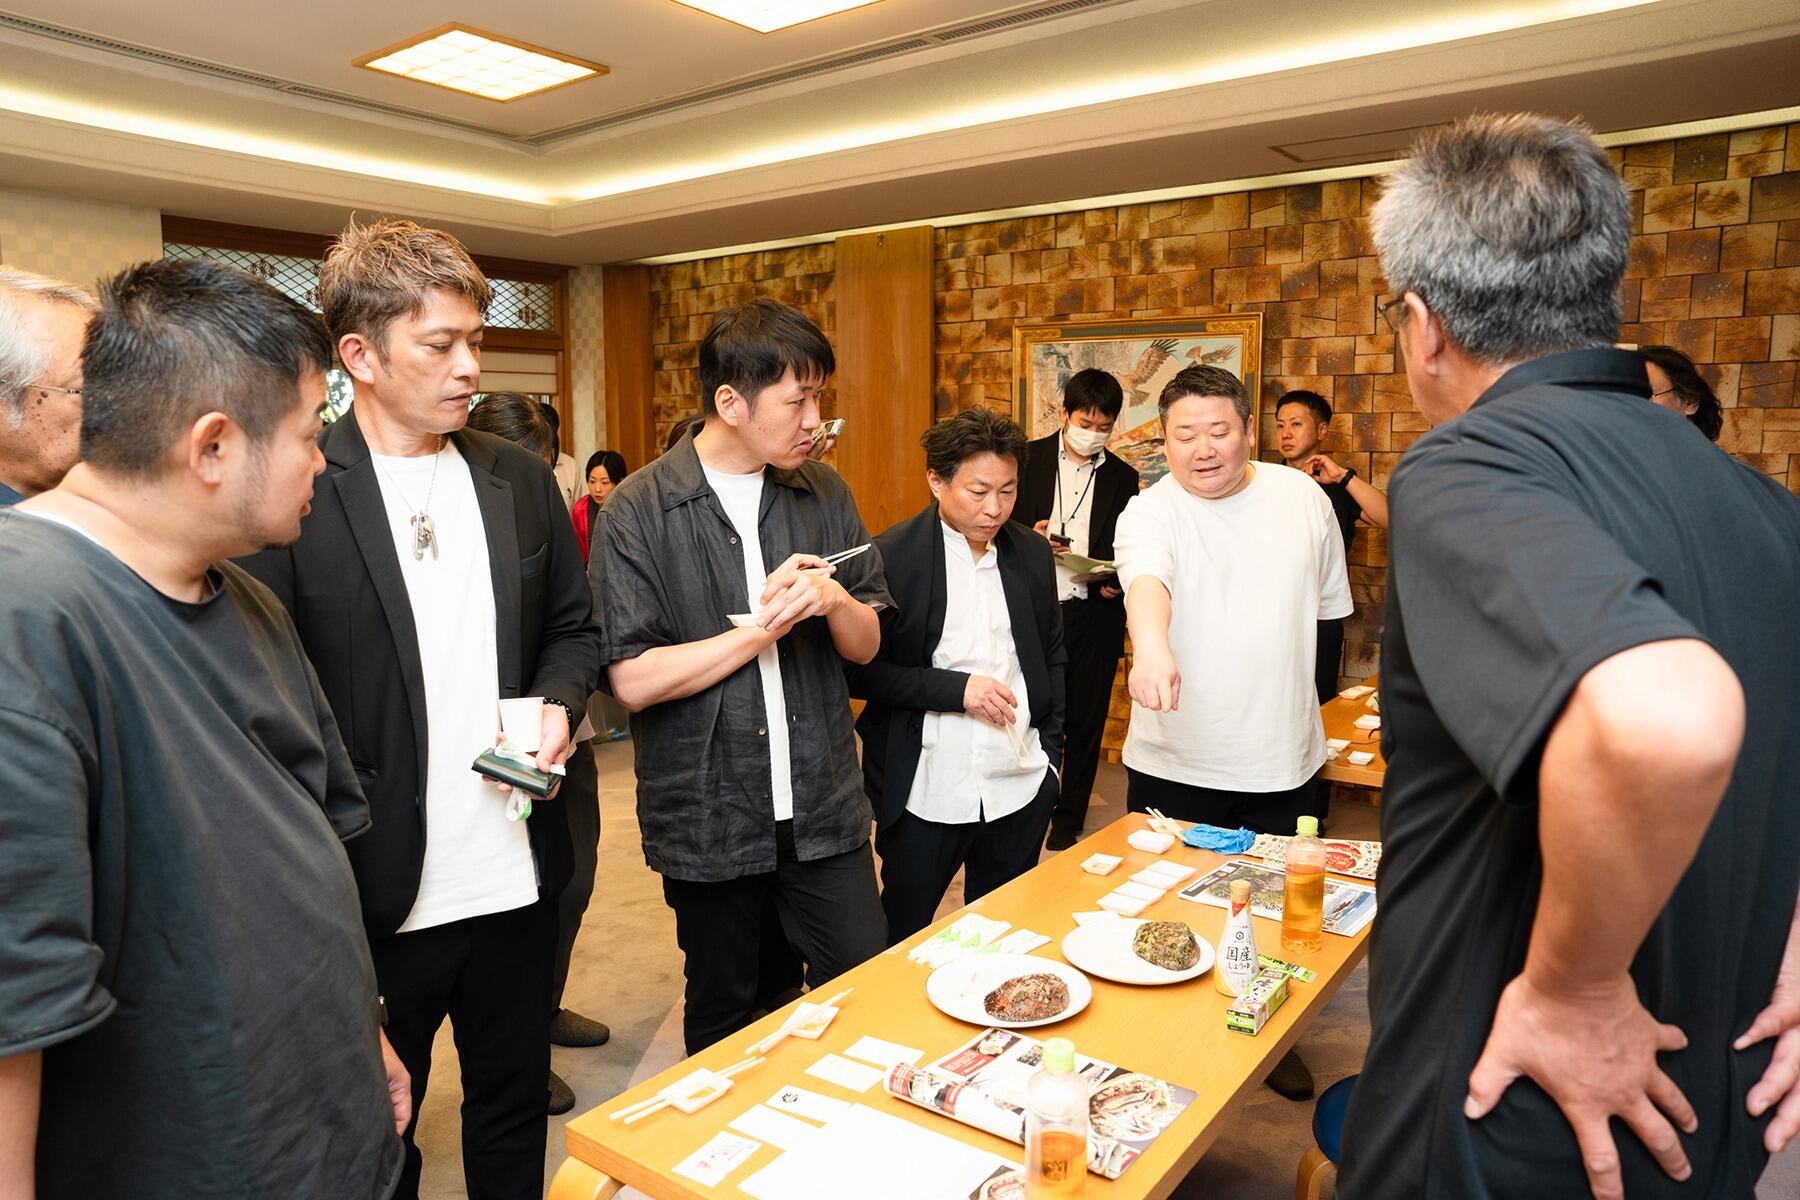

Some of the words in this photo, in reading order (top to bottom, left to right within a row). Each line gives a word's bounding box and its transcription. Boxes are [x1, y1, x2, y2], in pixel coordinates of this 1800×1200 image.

[1227, 946, 1251, 961] 国産
[1228, 961, 1250, 970] しょうゆ
